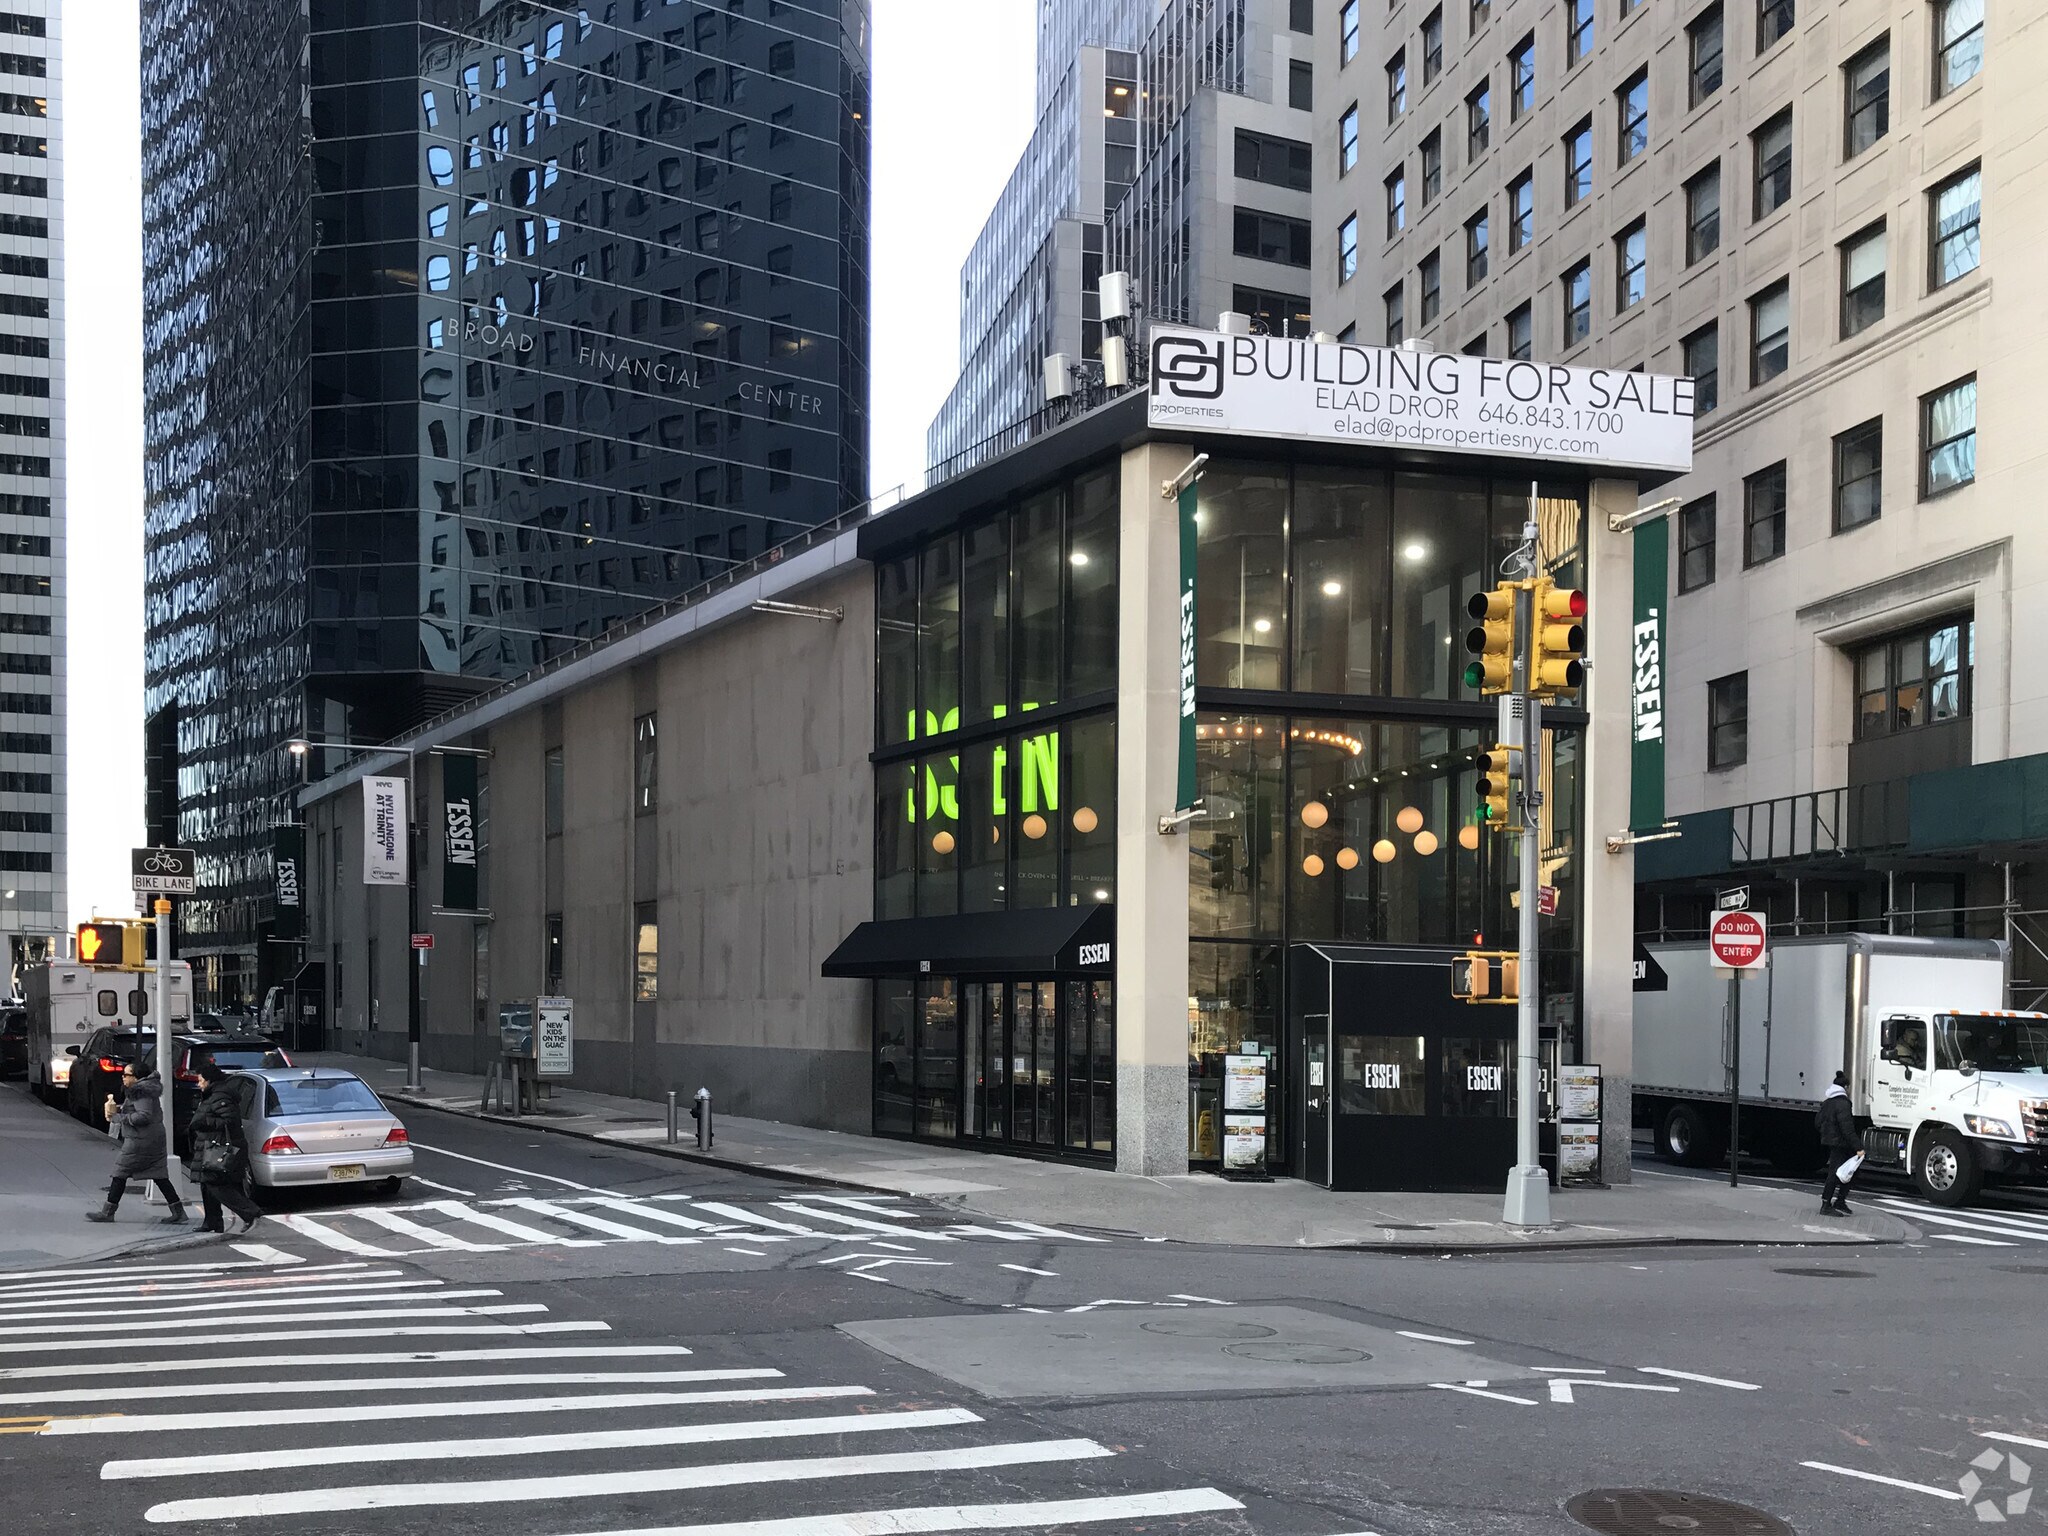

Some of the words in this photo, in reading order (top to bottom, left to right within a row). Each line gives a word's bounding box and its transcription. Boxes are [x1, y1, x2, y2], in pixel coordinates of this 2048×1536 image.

[447, 318, 534, 353] BROAD
[578, 346, 701, 390] FINANCIAL
[738, 381, 823, 416] CENTER
[1232, 336, 1459, 395] BUILDING
[1480, 359, 1572, 405] FOR
[1588, 369, 1695, 417] SALE
[1151, 404, 1224, 418] PROPERTIES
[1316, 387, 1380, 413] ELAD
[1389, 393, 1459, 421] DROR
[1478, 402, 1624, 434] 646.843.1700
[1334, 413, 1599, 455] elad@pdpropertiesnyc.com
[376, 794, 385, 806] AT
[385, 794, 394, 815] NYU
[377, 807, 386, 847] TRINITY
[385, 816, 395, 861] LANGONE
[135, 876, 159, 888] BIKE
[163, 877, 192, 889] LANE
[1722, 897, 1732, 907] ONE
[1735, 894, 1745, 903] WAY
[1720, 922, 1734, 932] DO
[1736, 923, 1756, 933] NOT
[1079, 942, 1111, 966] ESSEN
[1722, 946, 1753, 957] ENTER
[1364, 1063, 1401, 1089] ESSEN
[1466, 1065, 1502, 1091] ESSEN
